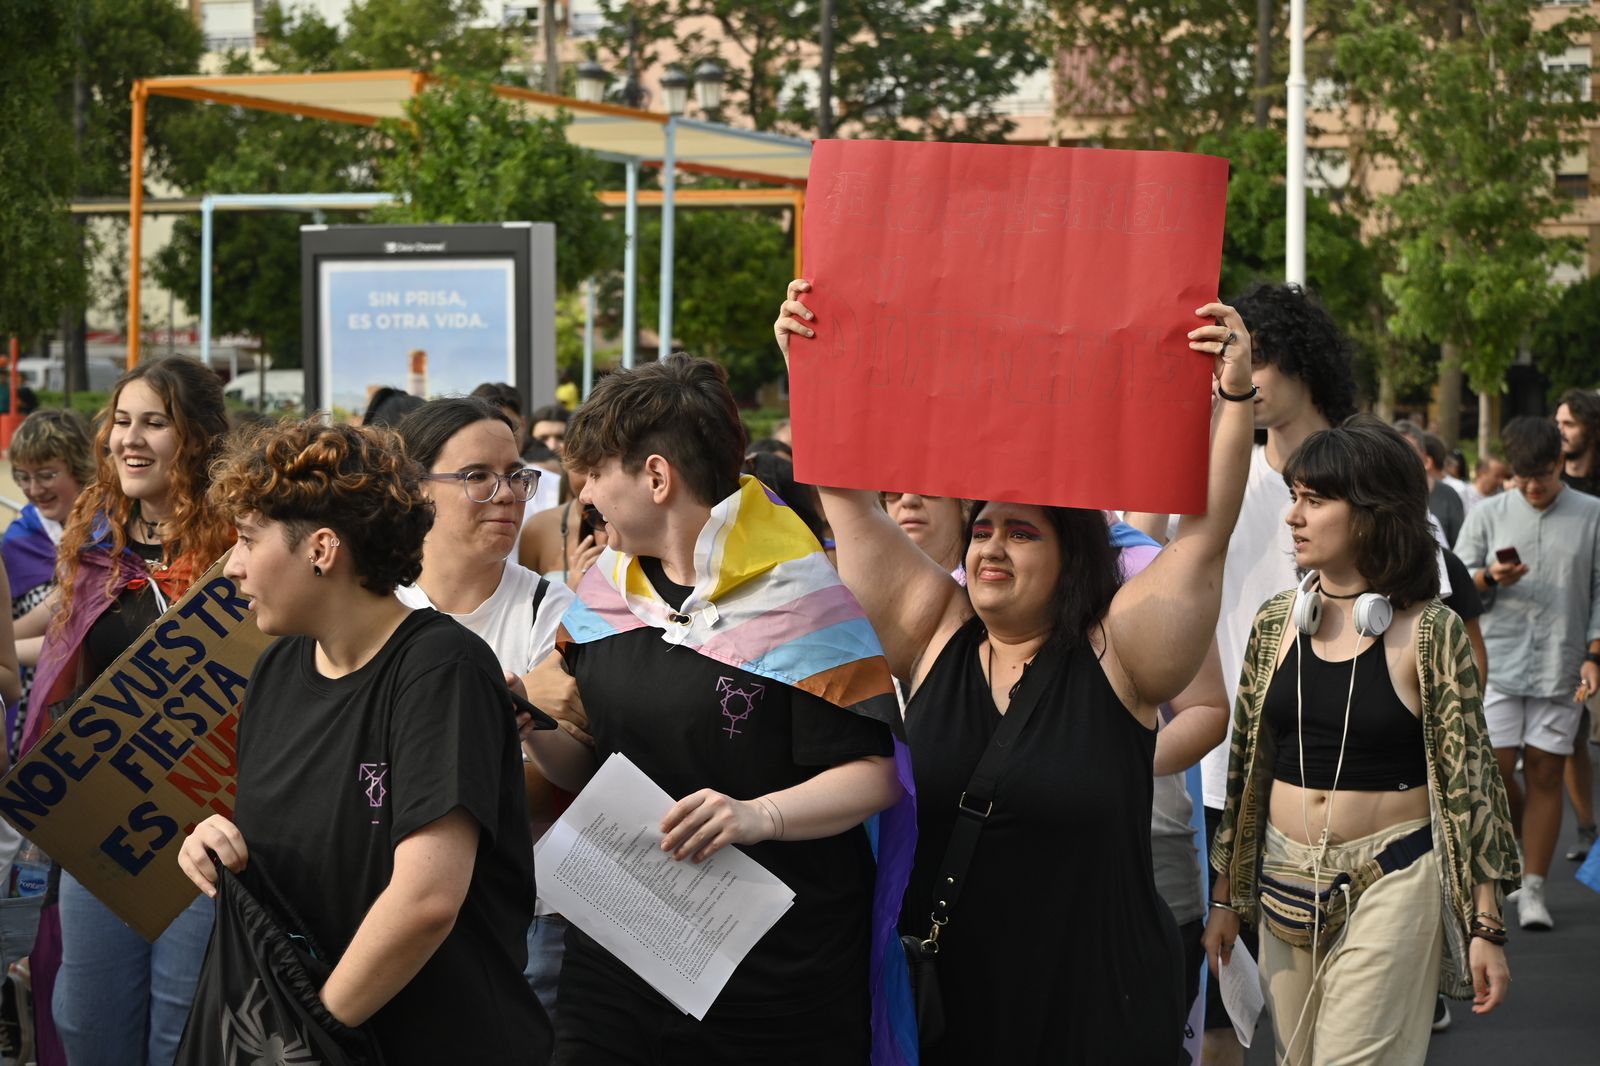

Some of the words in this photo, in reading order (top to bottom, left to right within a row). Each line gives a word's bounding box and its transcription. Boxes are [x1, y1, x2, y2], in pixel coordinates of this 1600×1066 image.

[348, 312, 372, 330] ES
[376, 312, 430, 330] OTRA
[434, 311, 488, 329] VIDA.
[368, 290, 400, 307] SIN
[404, 289, 467, 308] PRISA,
[109, 660, 249, 794] FIESTA
[101, 801, 179, 877] ES
